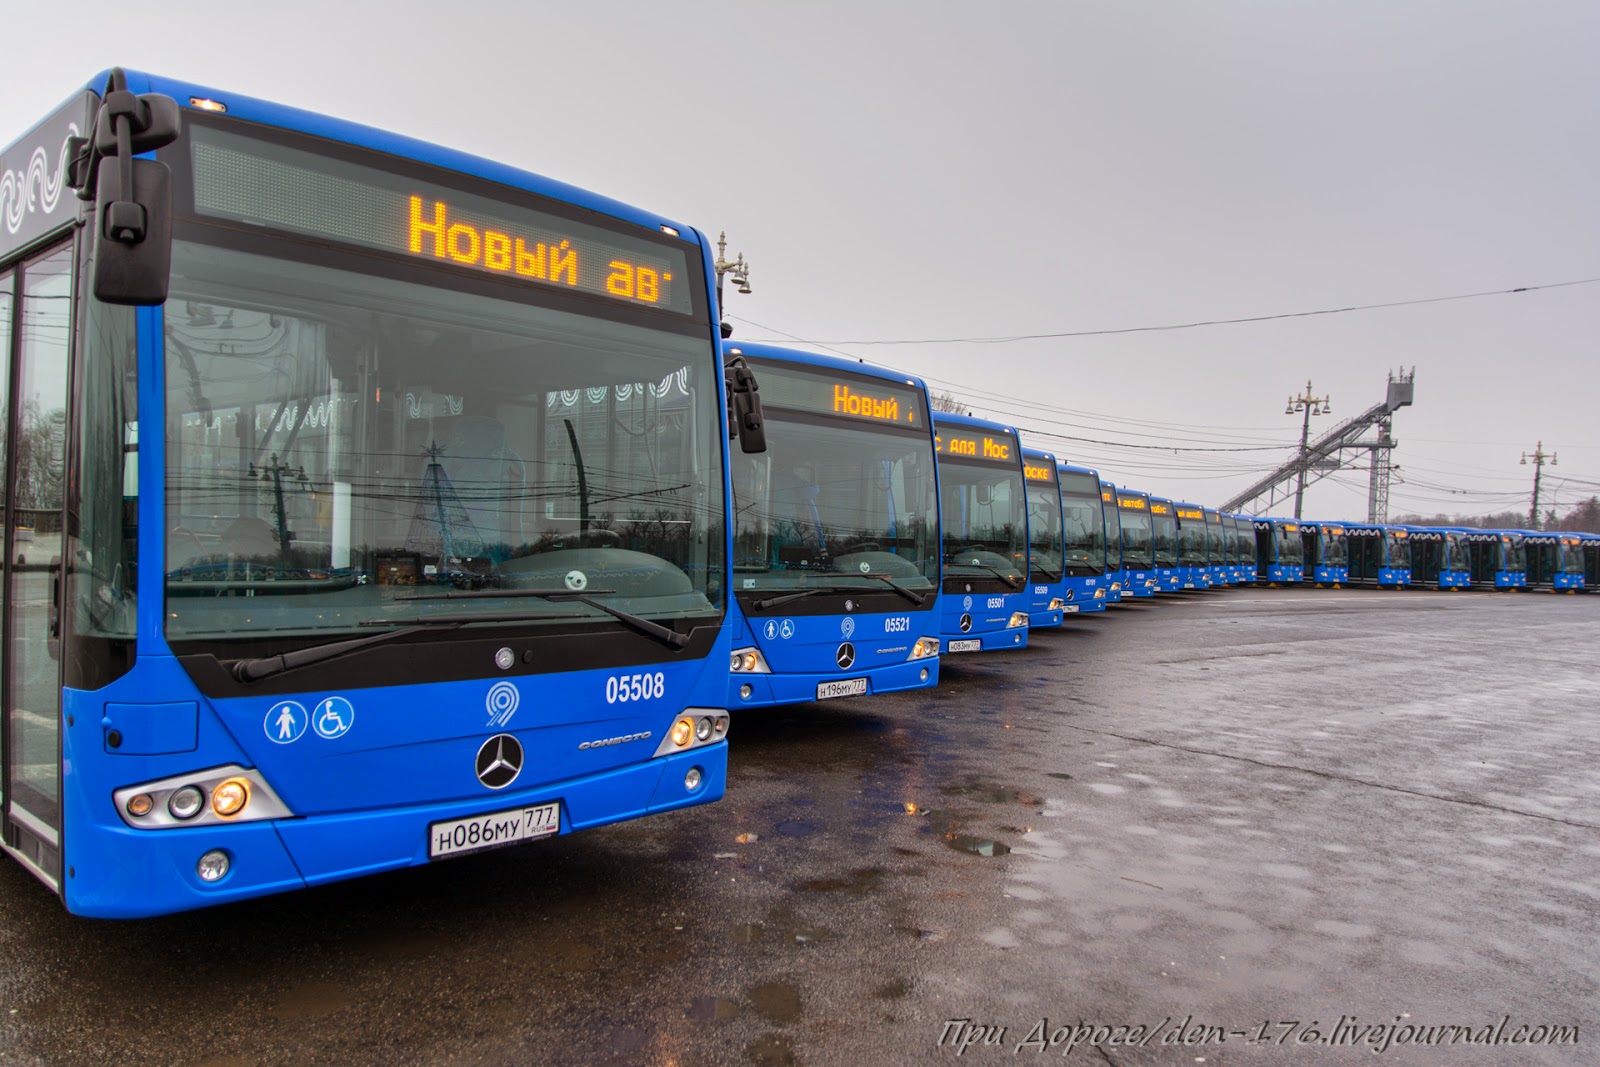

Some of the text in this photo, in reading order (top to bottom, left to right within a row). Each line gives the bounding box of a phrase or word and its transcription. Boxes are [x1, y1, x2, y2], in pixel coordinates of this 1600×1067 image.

[409, 195, 672, 303] Новый ав
[833, 384, 899, 421] Новый
[983, 437, 1009, 459] Мос
[987, 597, 1005, 609] 05501
[884, 616, 910, 633] 05521
[605, 671, 665, 704] 05508
[578, 731, 653, 751] CONECTO
[524, 806, 554, 828] 777
[531, 824, 546, 834] RUS
